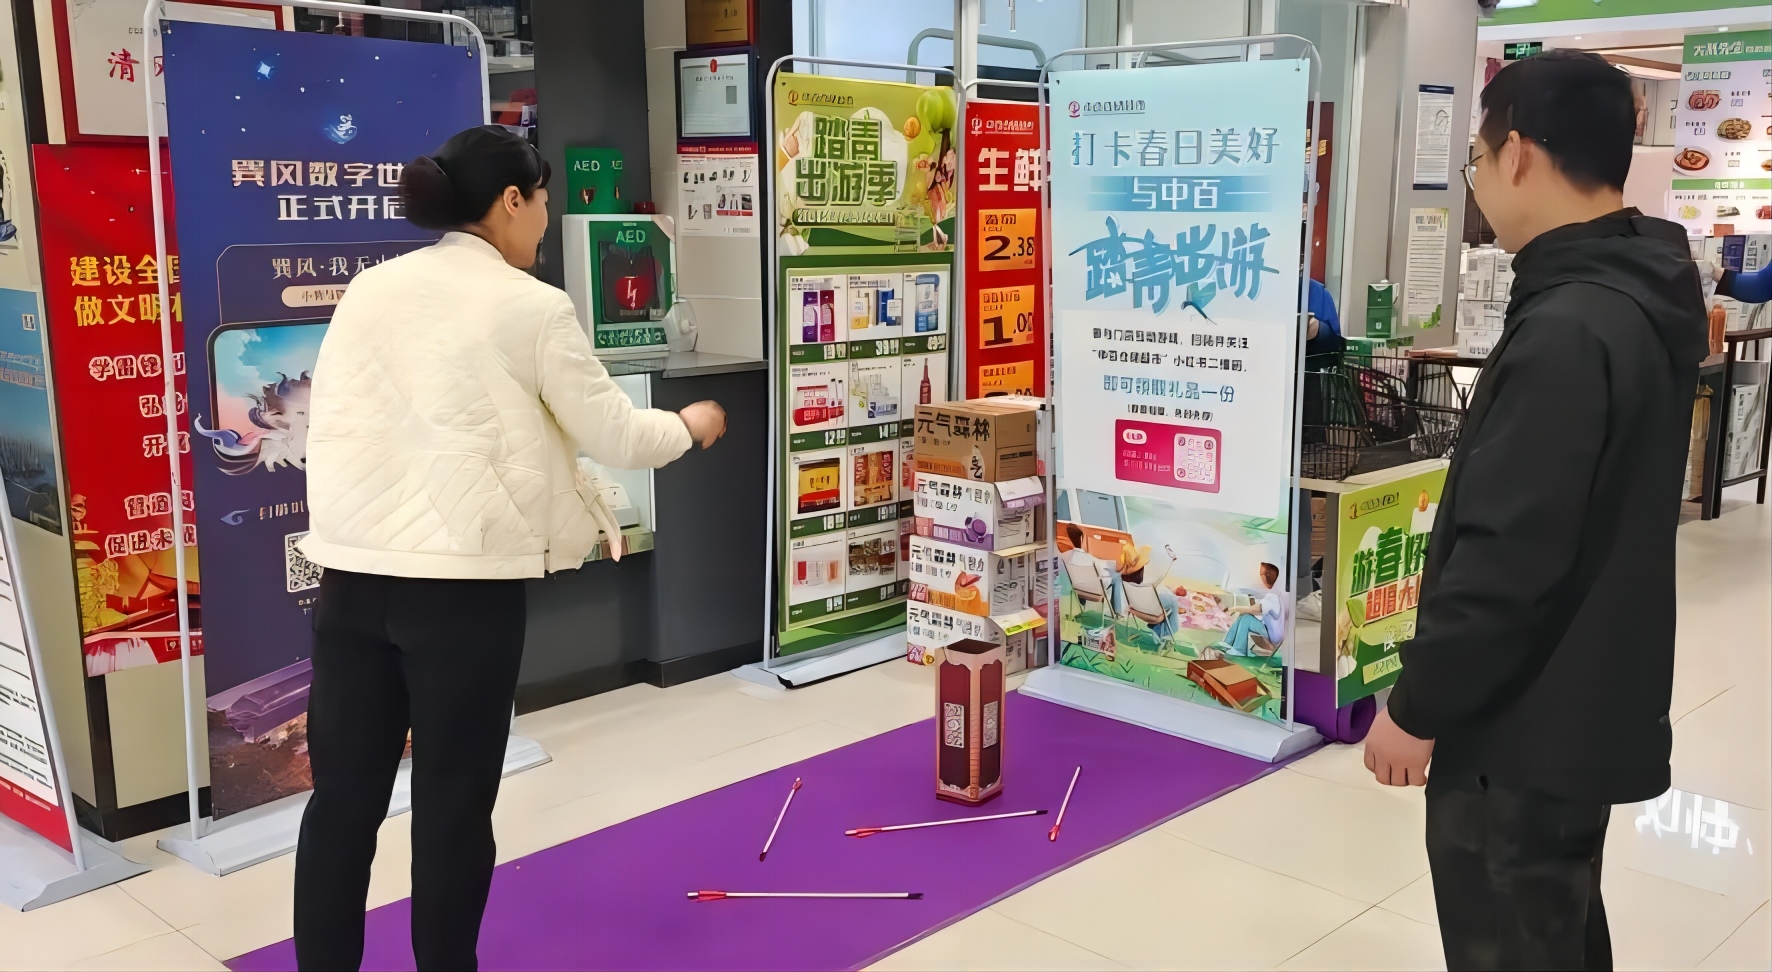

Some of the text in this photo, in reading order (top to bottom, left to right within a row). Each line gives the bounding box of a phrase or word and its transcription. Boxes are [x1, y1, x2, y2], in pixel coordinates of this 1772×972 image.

[812, 109, 881, 161] 踏青
[1071, 127, 1280, 167] 打卡春日美好
[573, 160, 600, 171] AED
[796, 158, 897, 206] 出游季
[1131, 176, 1221, 211] 与中百
[615, 229, 646, 243] AED
[983, 235, 1034, 261] 2.38
